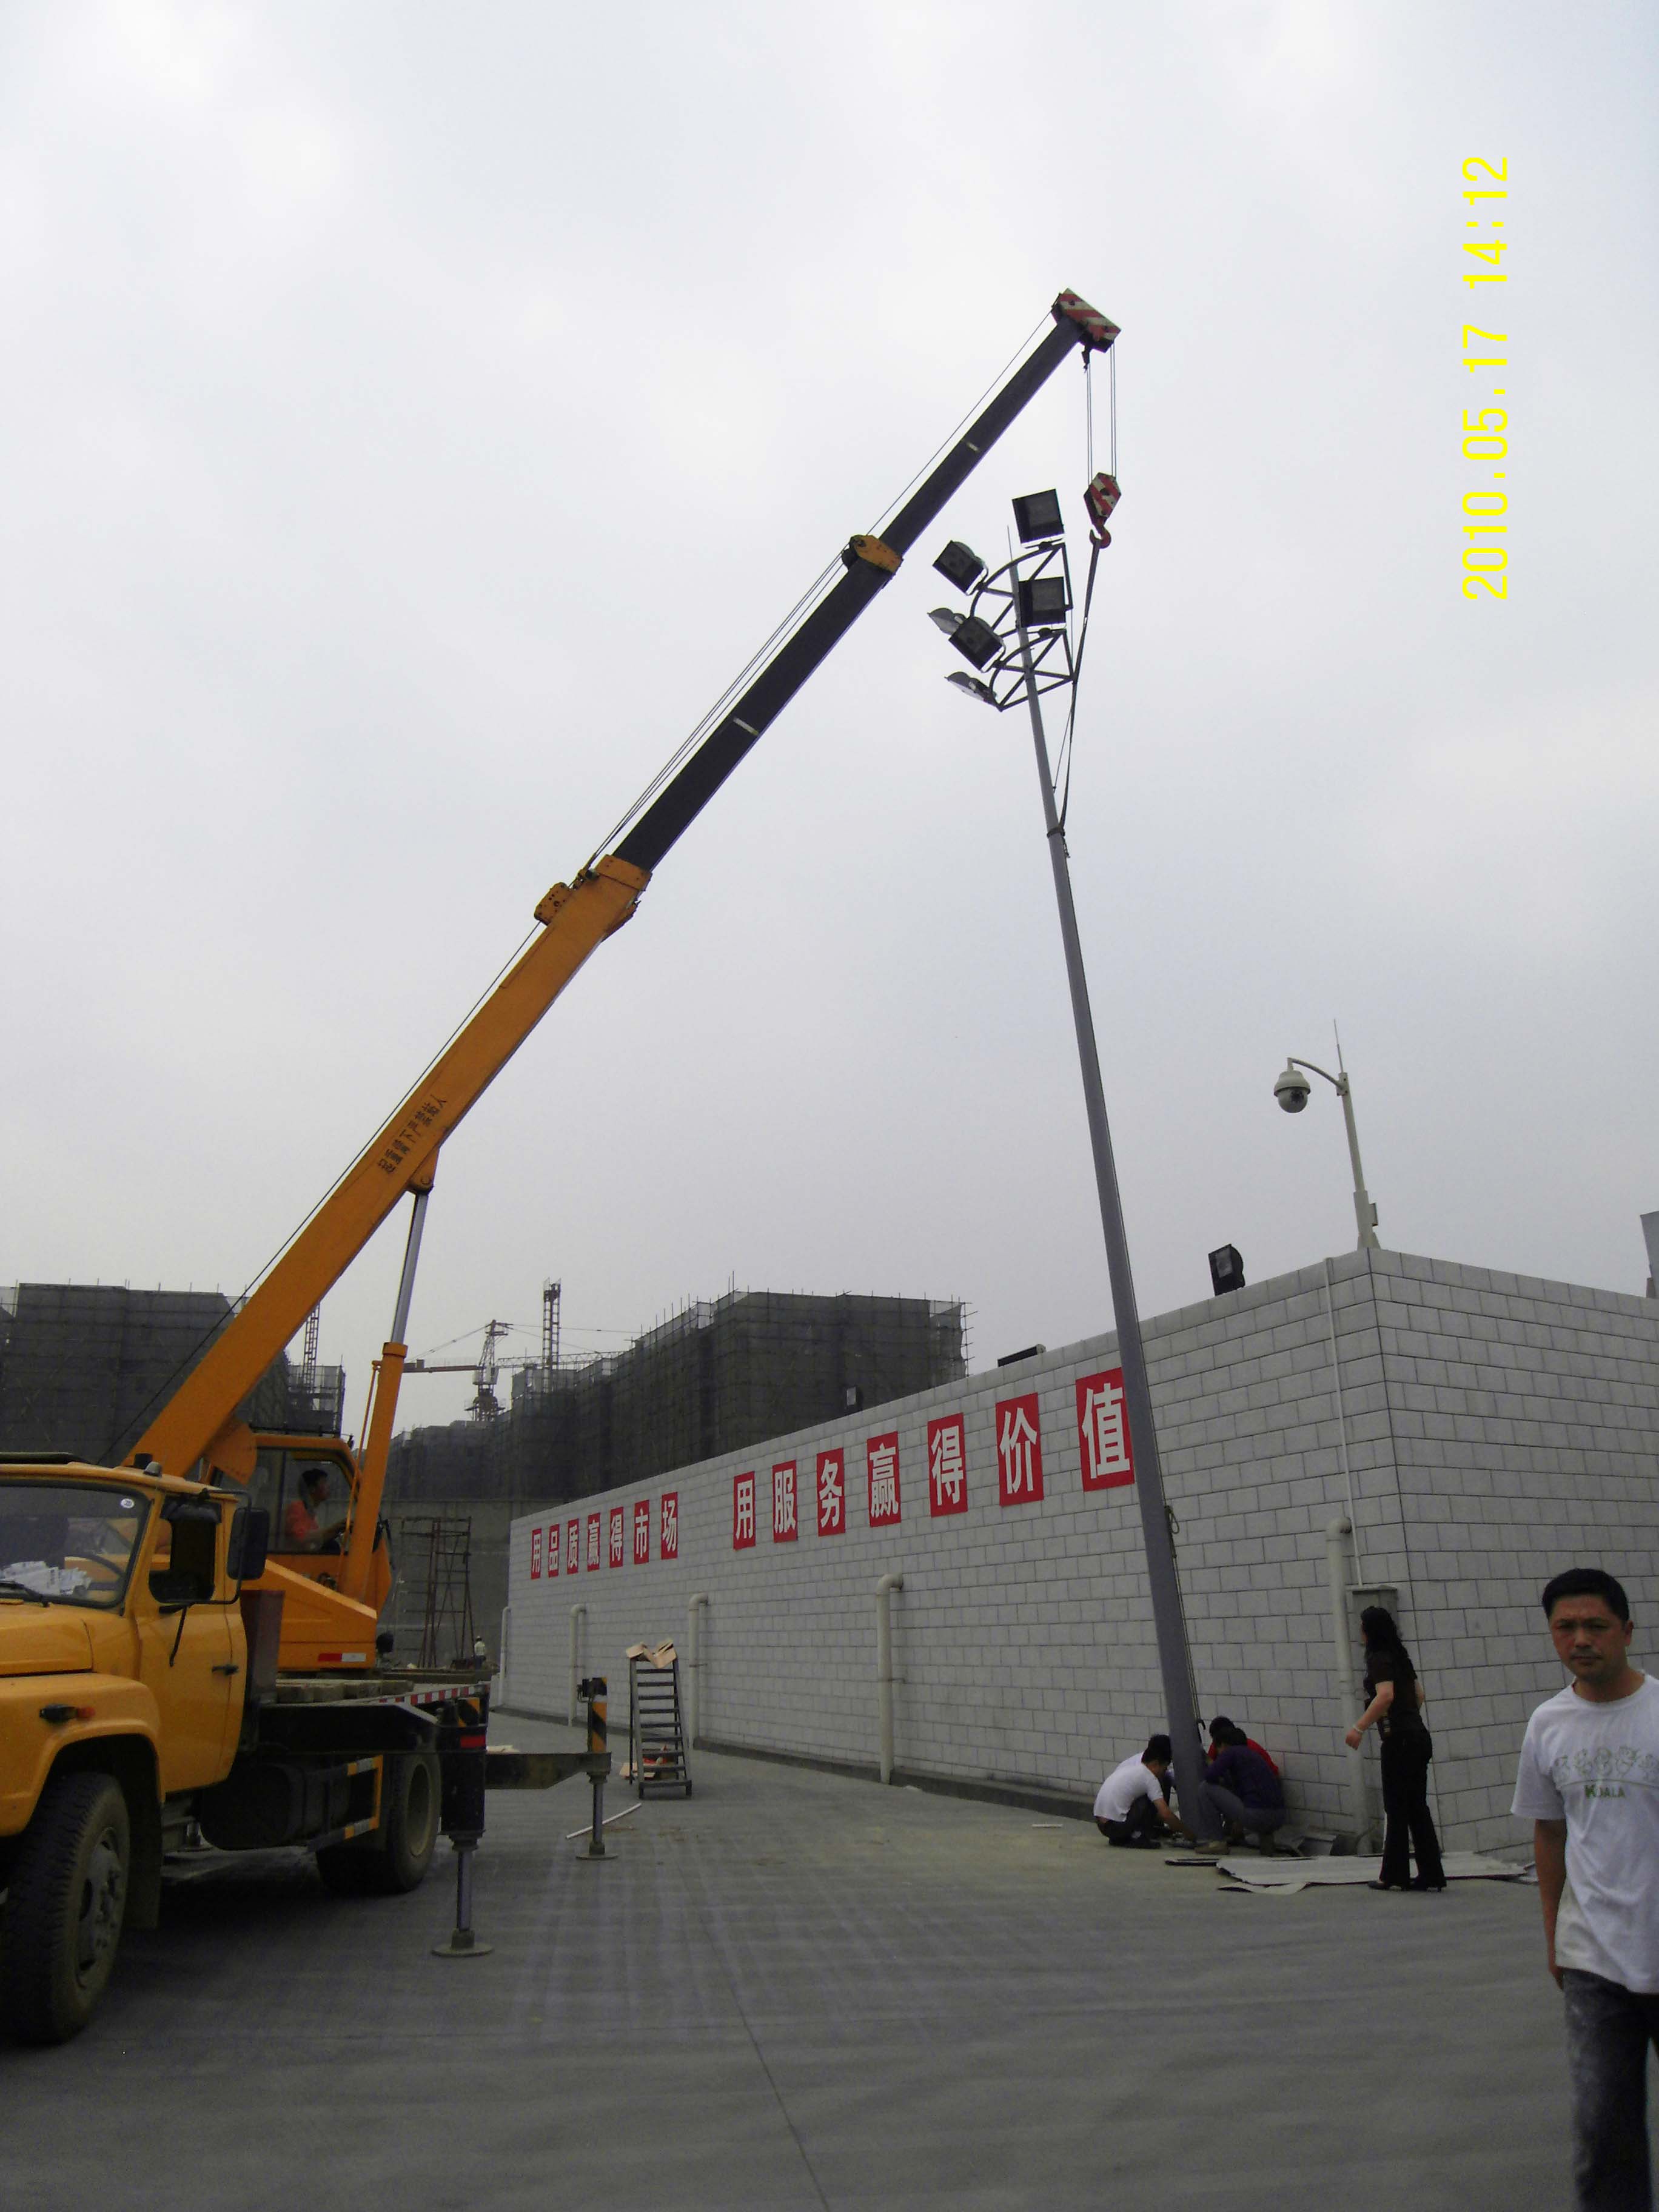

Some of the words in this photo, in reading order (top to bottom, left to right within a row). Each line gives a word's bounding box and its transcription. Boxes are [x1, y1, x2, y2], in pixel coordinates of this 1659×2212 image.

[531, 1499, 676, 1573] 用品质赢得市场
[735, 1382, 1131, 1539] 用服务赢得价值
